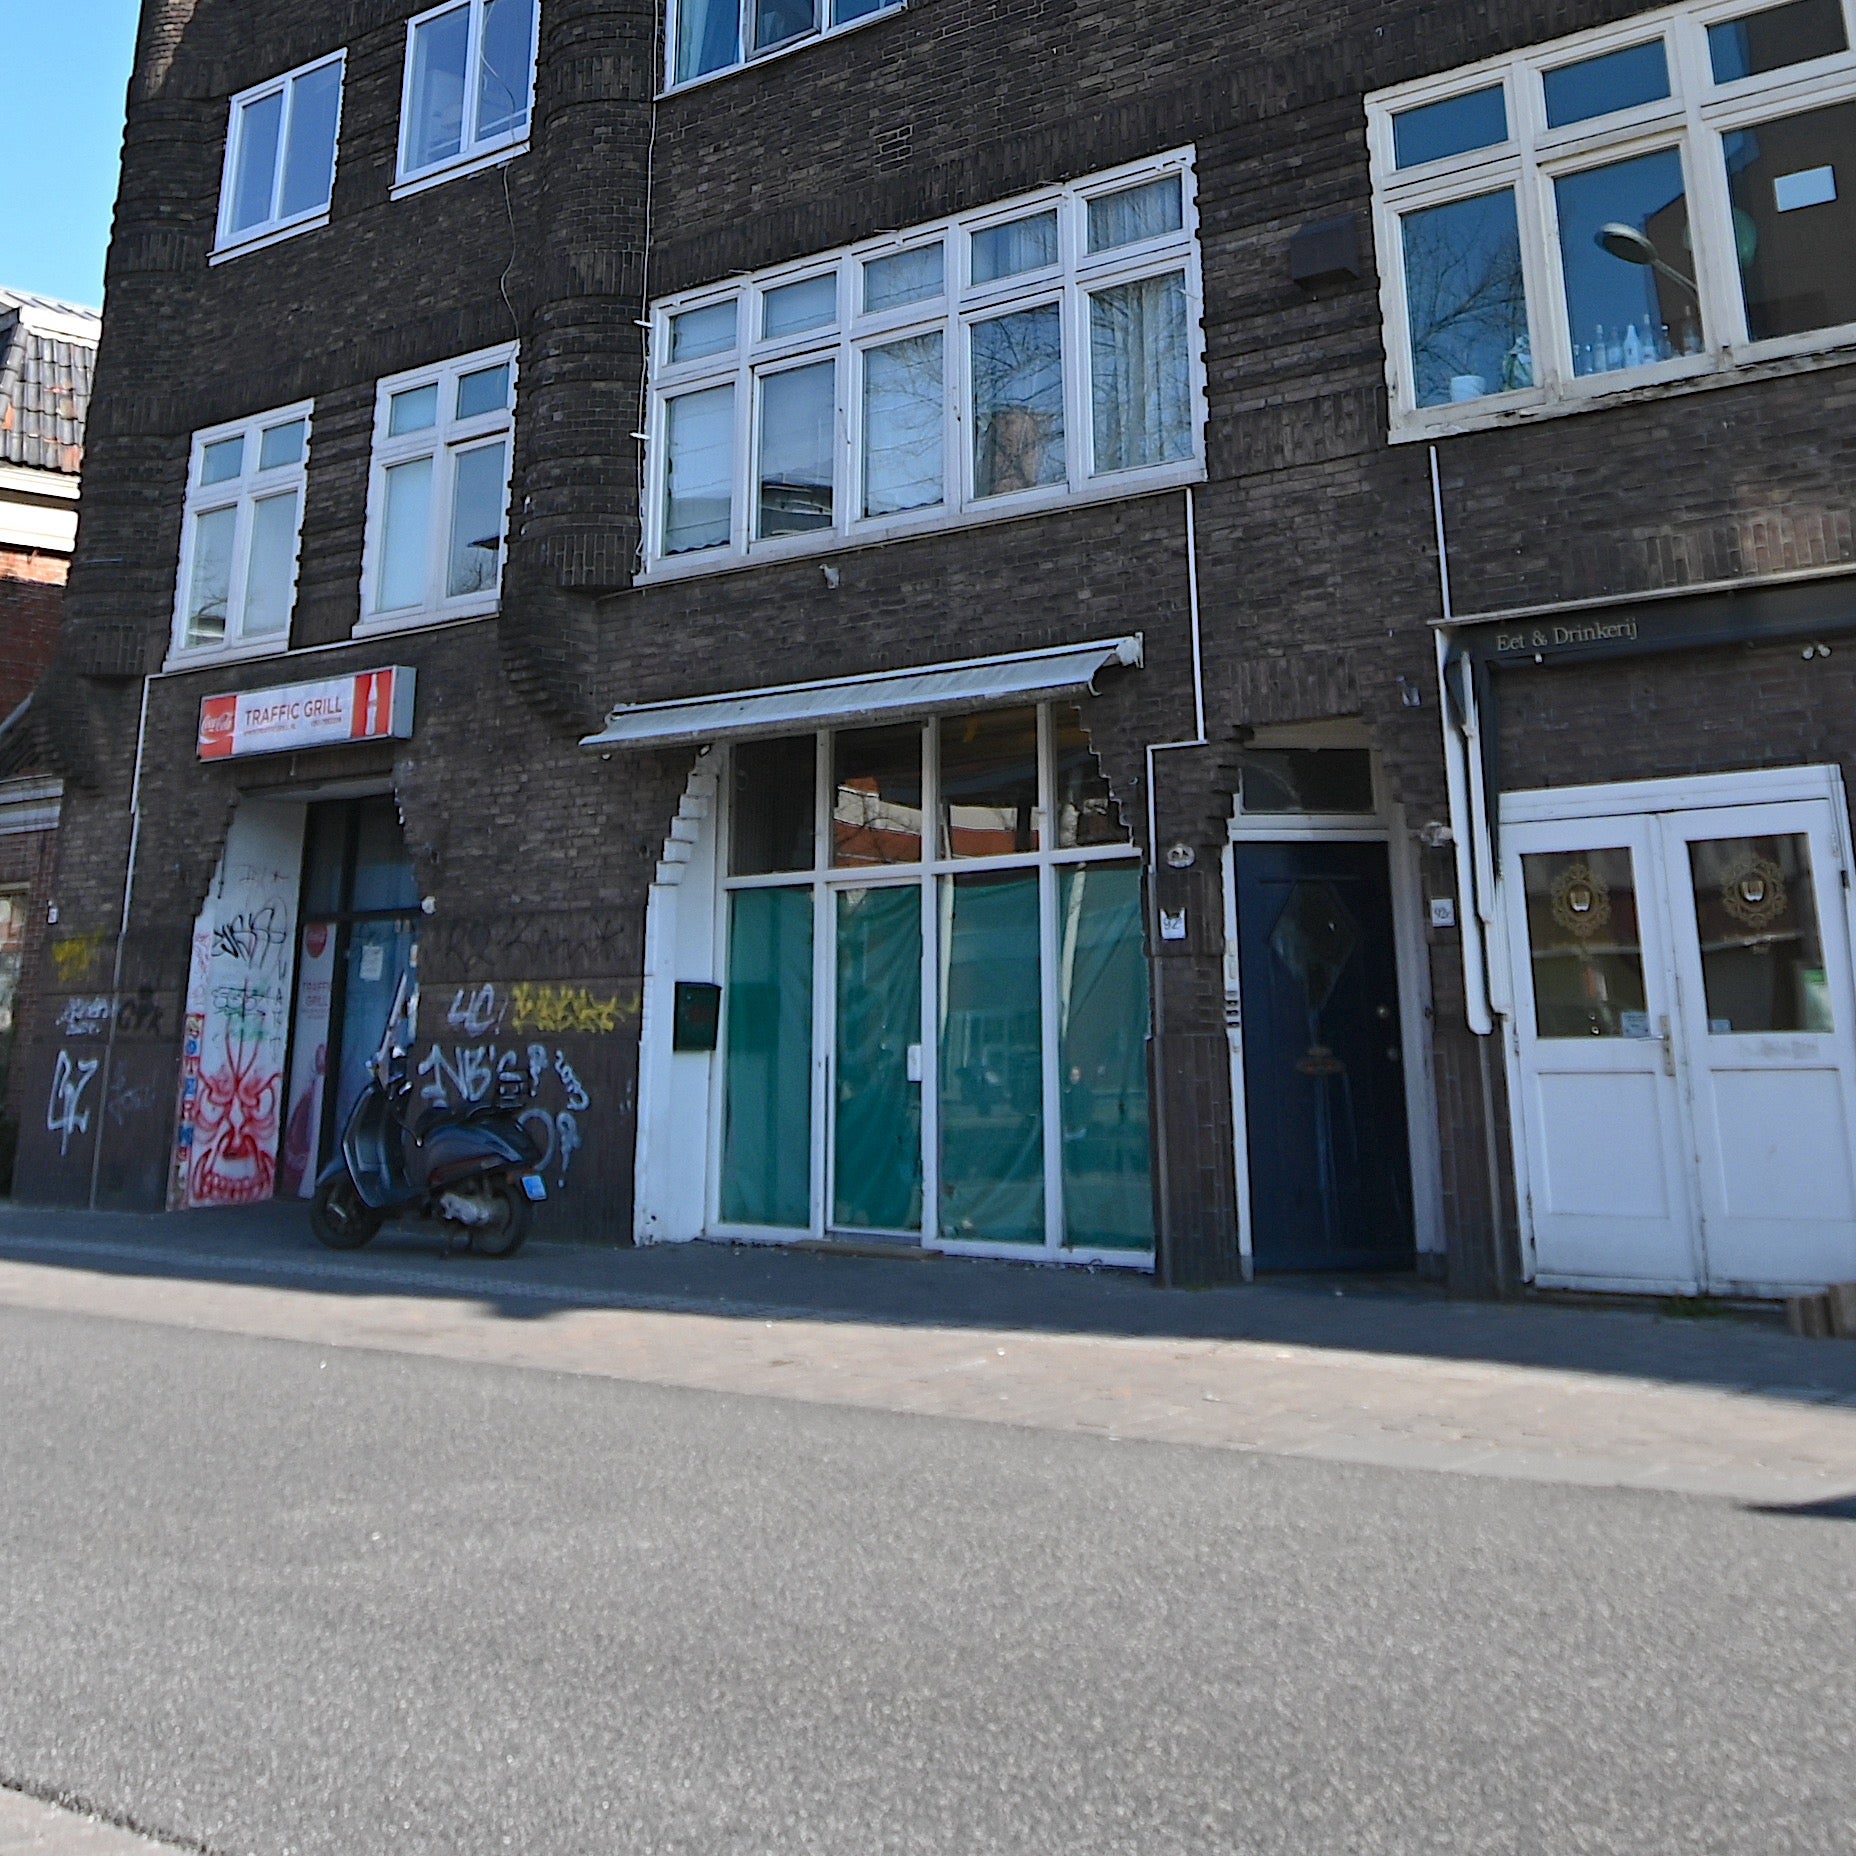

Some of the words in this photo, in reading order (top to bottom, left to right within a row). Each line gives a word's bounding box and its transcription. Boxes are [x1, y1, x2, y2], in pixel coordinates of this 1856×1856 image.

[1496, 634, 1525, 651] Eet
[1532, 630, 1548, 647] &
[1553, 618, 1638, 645] Drinkerij
[245, 702, 300, 726] TRAFFIC
[303, 696, 342, 718] GRILL
